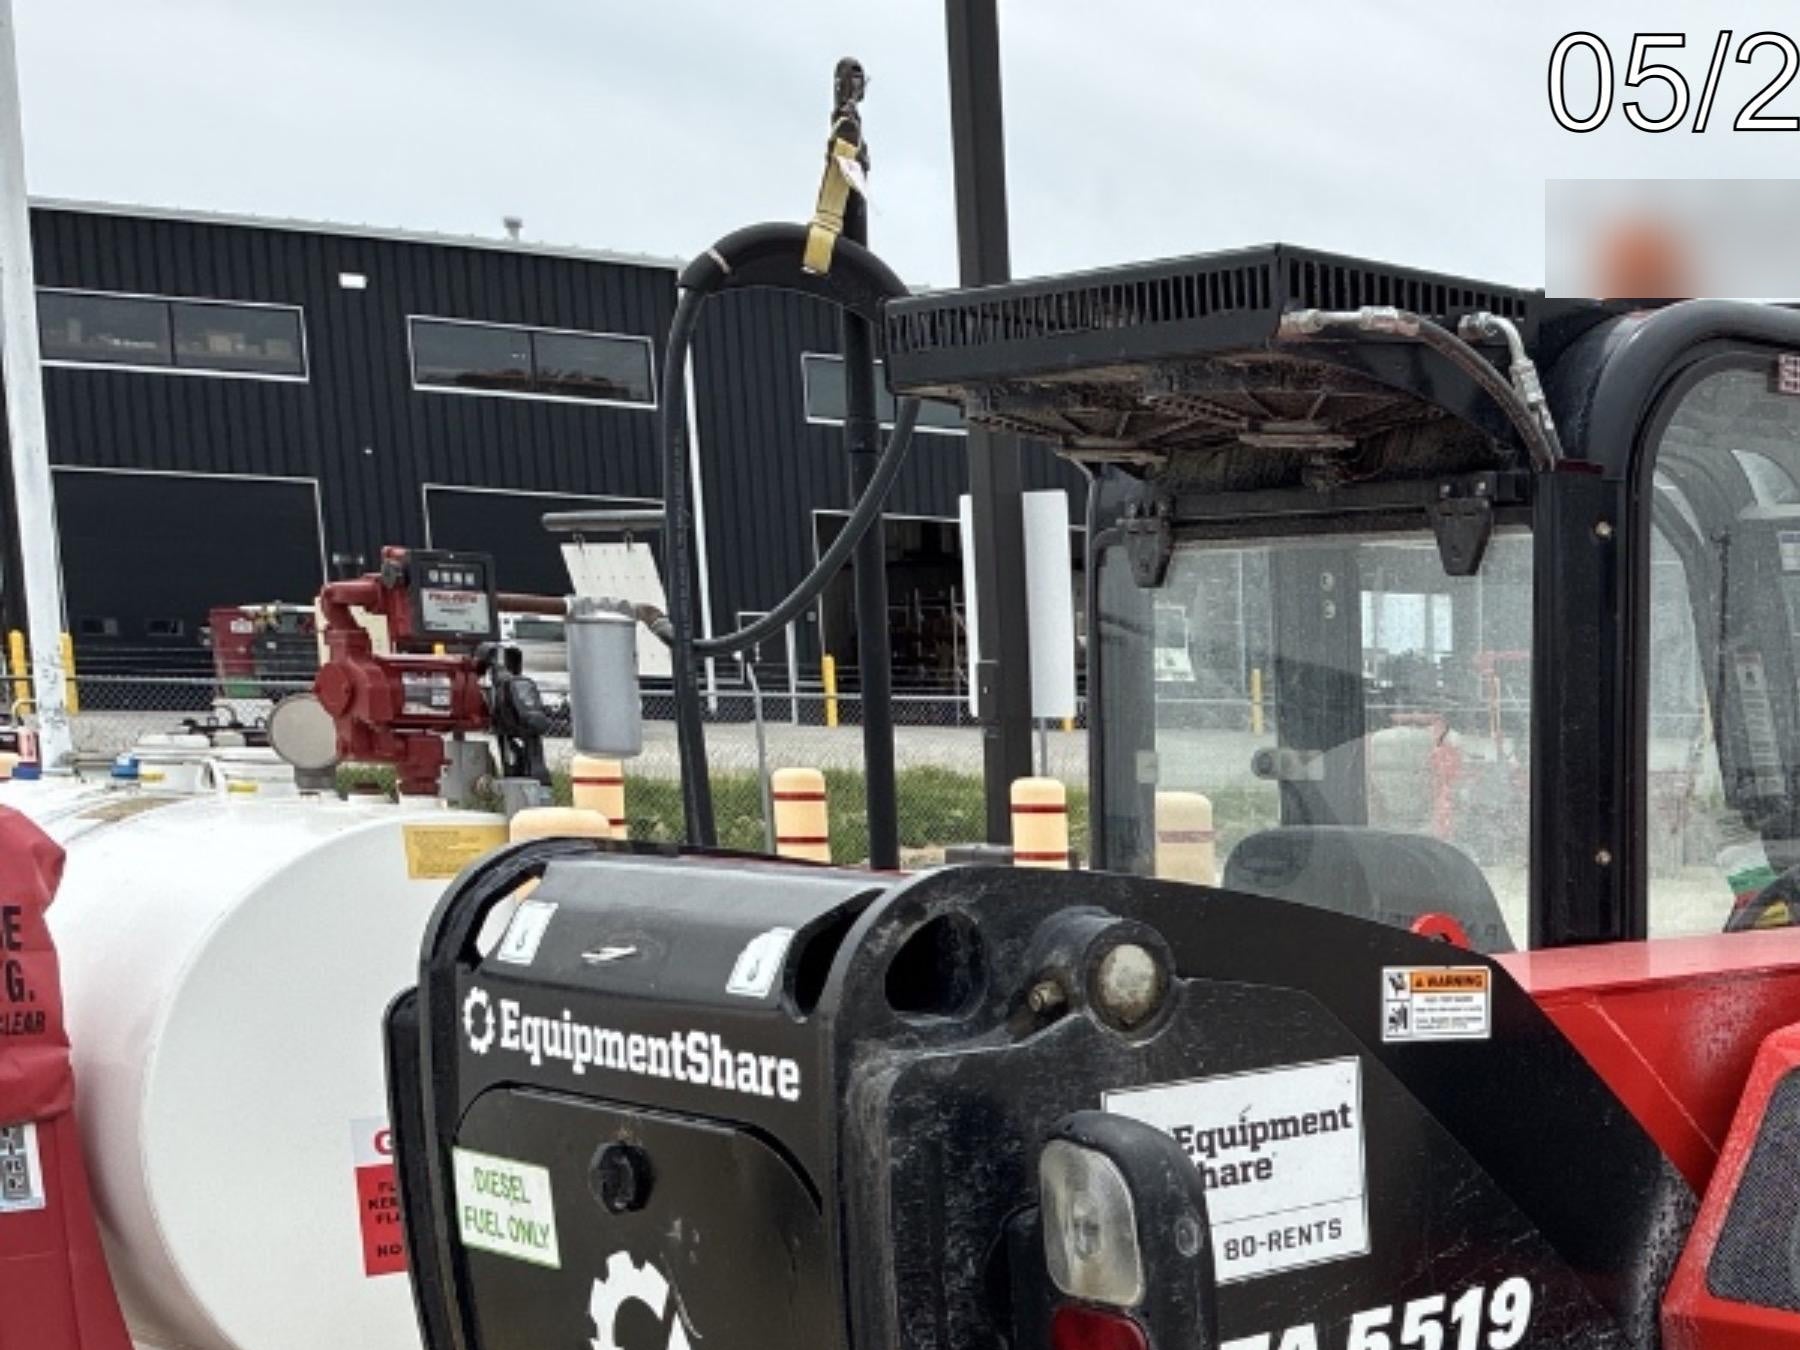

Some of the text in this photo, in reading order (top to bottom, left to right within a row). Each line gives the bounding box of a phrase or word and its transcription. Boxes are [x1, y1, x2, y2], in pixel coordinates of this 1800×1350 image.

[499, 998, 802, 1102] EquipmentShare
[1173, 1103, 1354, 1159] Equipment
[473, 1166, 532, 1205] DIESEL
[1196, 1155, 1273, 1189] hare
[464, 1204, 551, 1250] FUEL ONLY
